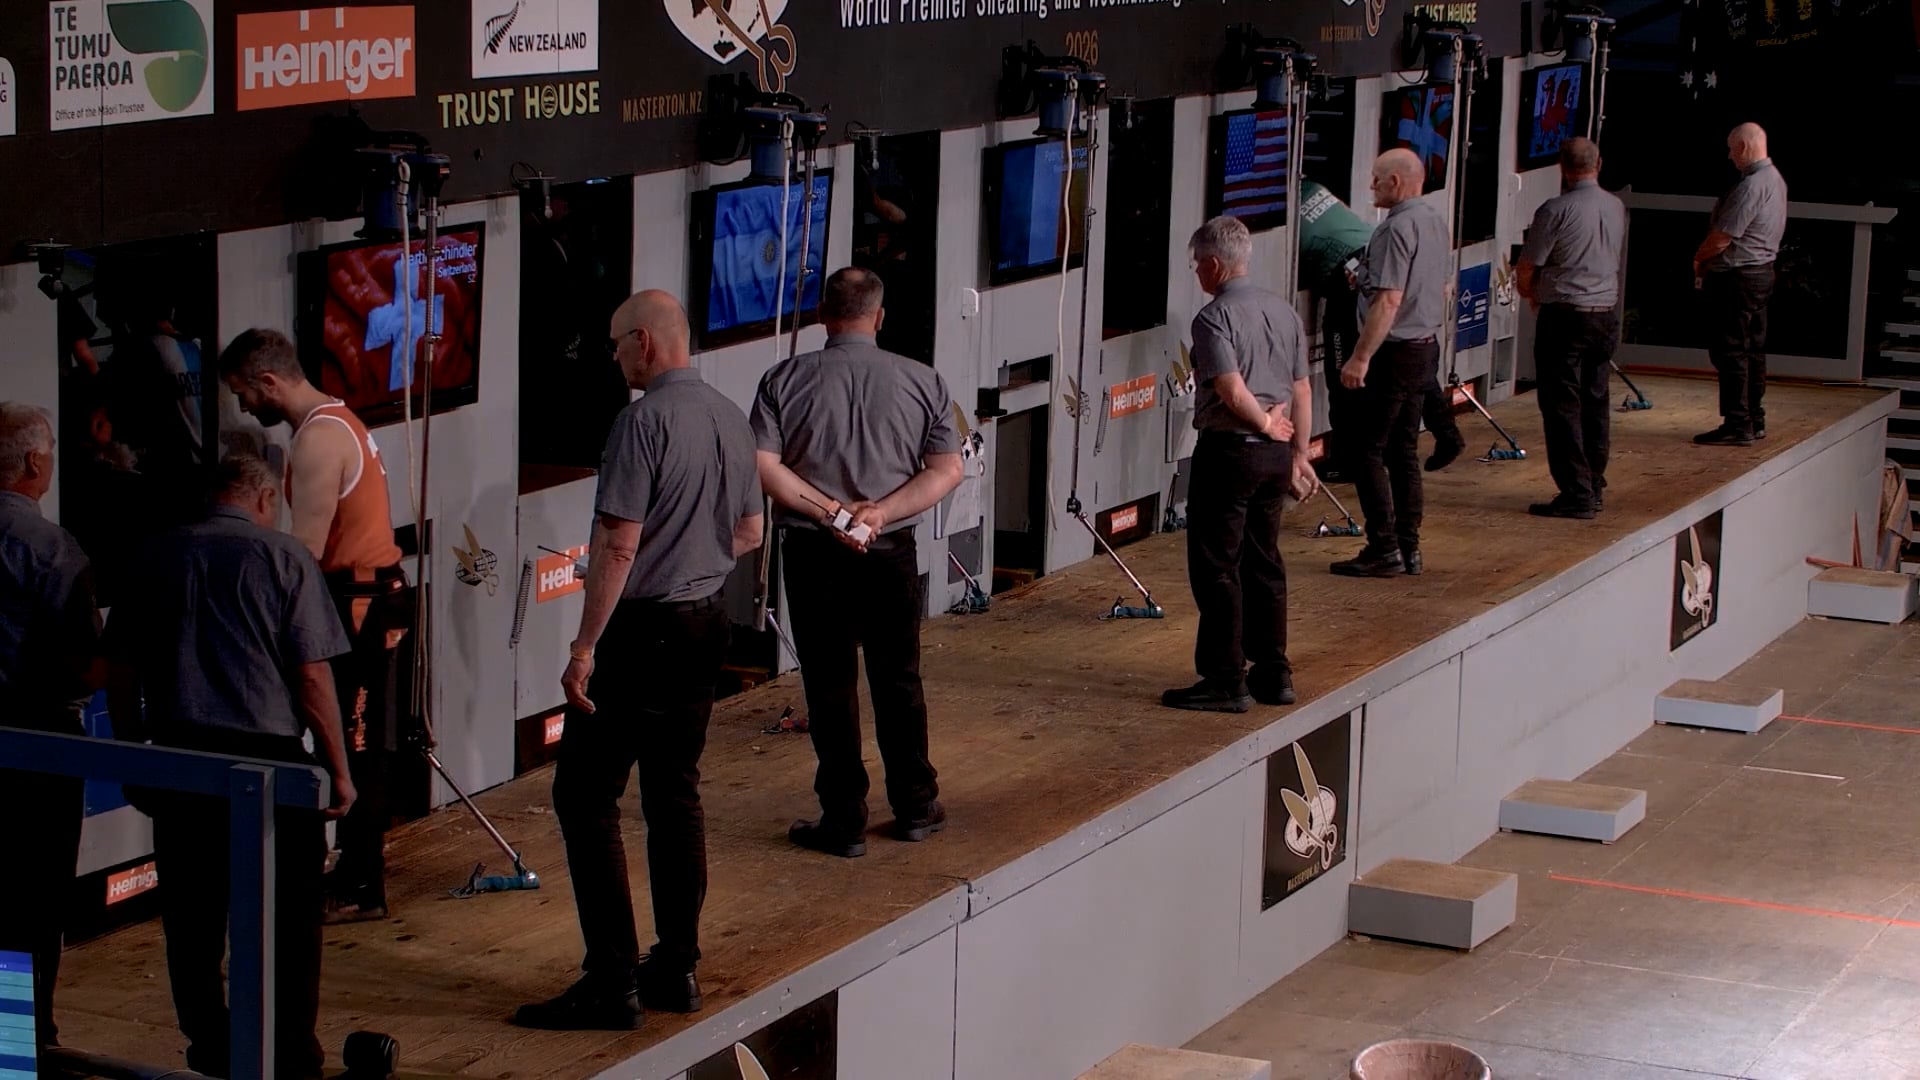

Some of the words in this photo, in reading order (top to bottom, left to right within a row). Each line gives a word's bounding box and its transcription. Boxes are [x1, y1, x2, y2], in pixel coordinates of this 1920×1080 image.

[54, 6, 77, 32] TE
[840, 0, 890, 28] World
[900, 0, 966, 23] Premier
[1413, 4, 1445, 23] TUST
[1447, 2, 1478, 24] HOUSE
[54, 33, 110, 61] TUMU
[244, 8, 412, 94] Heiniger
[509, 34, 535, 54] NEW
[536, 31, 587, 51] ZEALAND
[1065, 30, 1099, 66] 2026
[55, 60, 134, 91] PAEROA
[55, 108, 75, 121] Office
[437, 88, 515, 129] TRUST
[524, 80, 600, 119] HOUSE
[622, 90, 704, 124] MASTERTON.NZ
[401, 249, 428, 265] arti
[437, 260, 478, 278] Switzerland
[1112, 378, 1155, 412] Heiniger
[109, 863, 158, 898] Heinig
